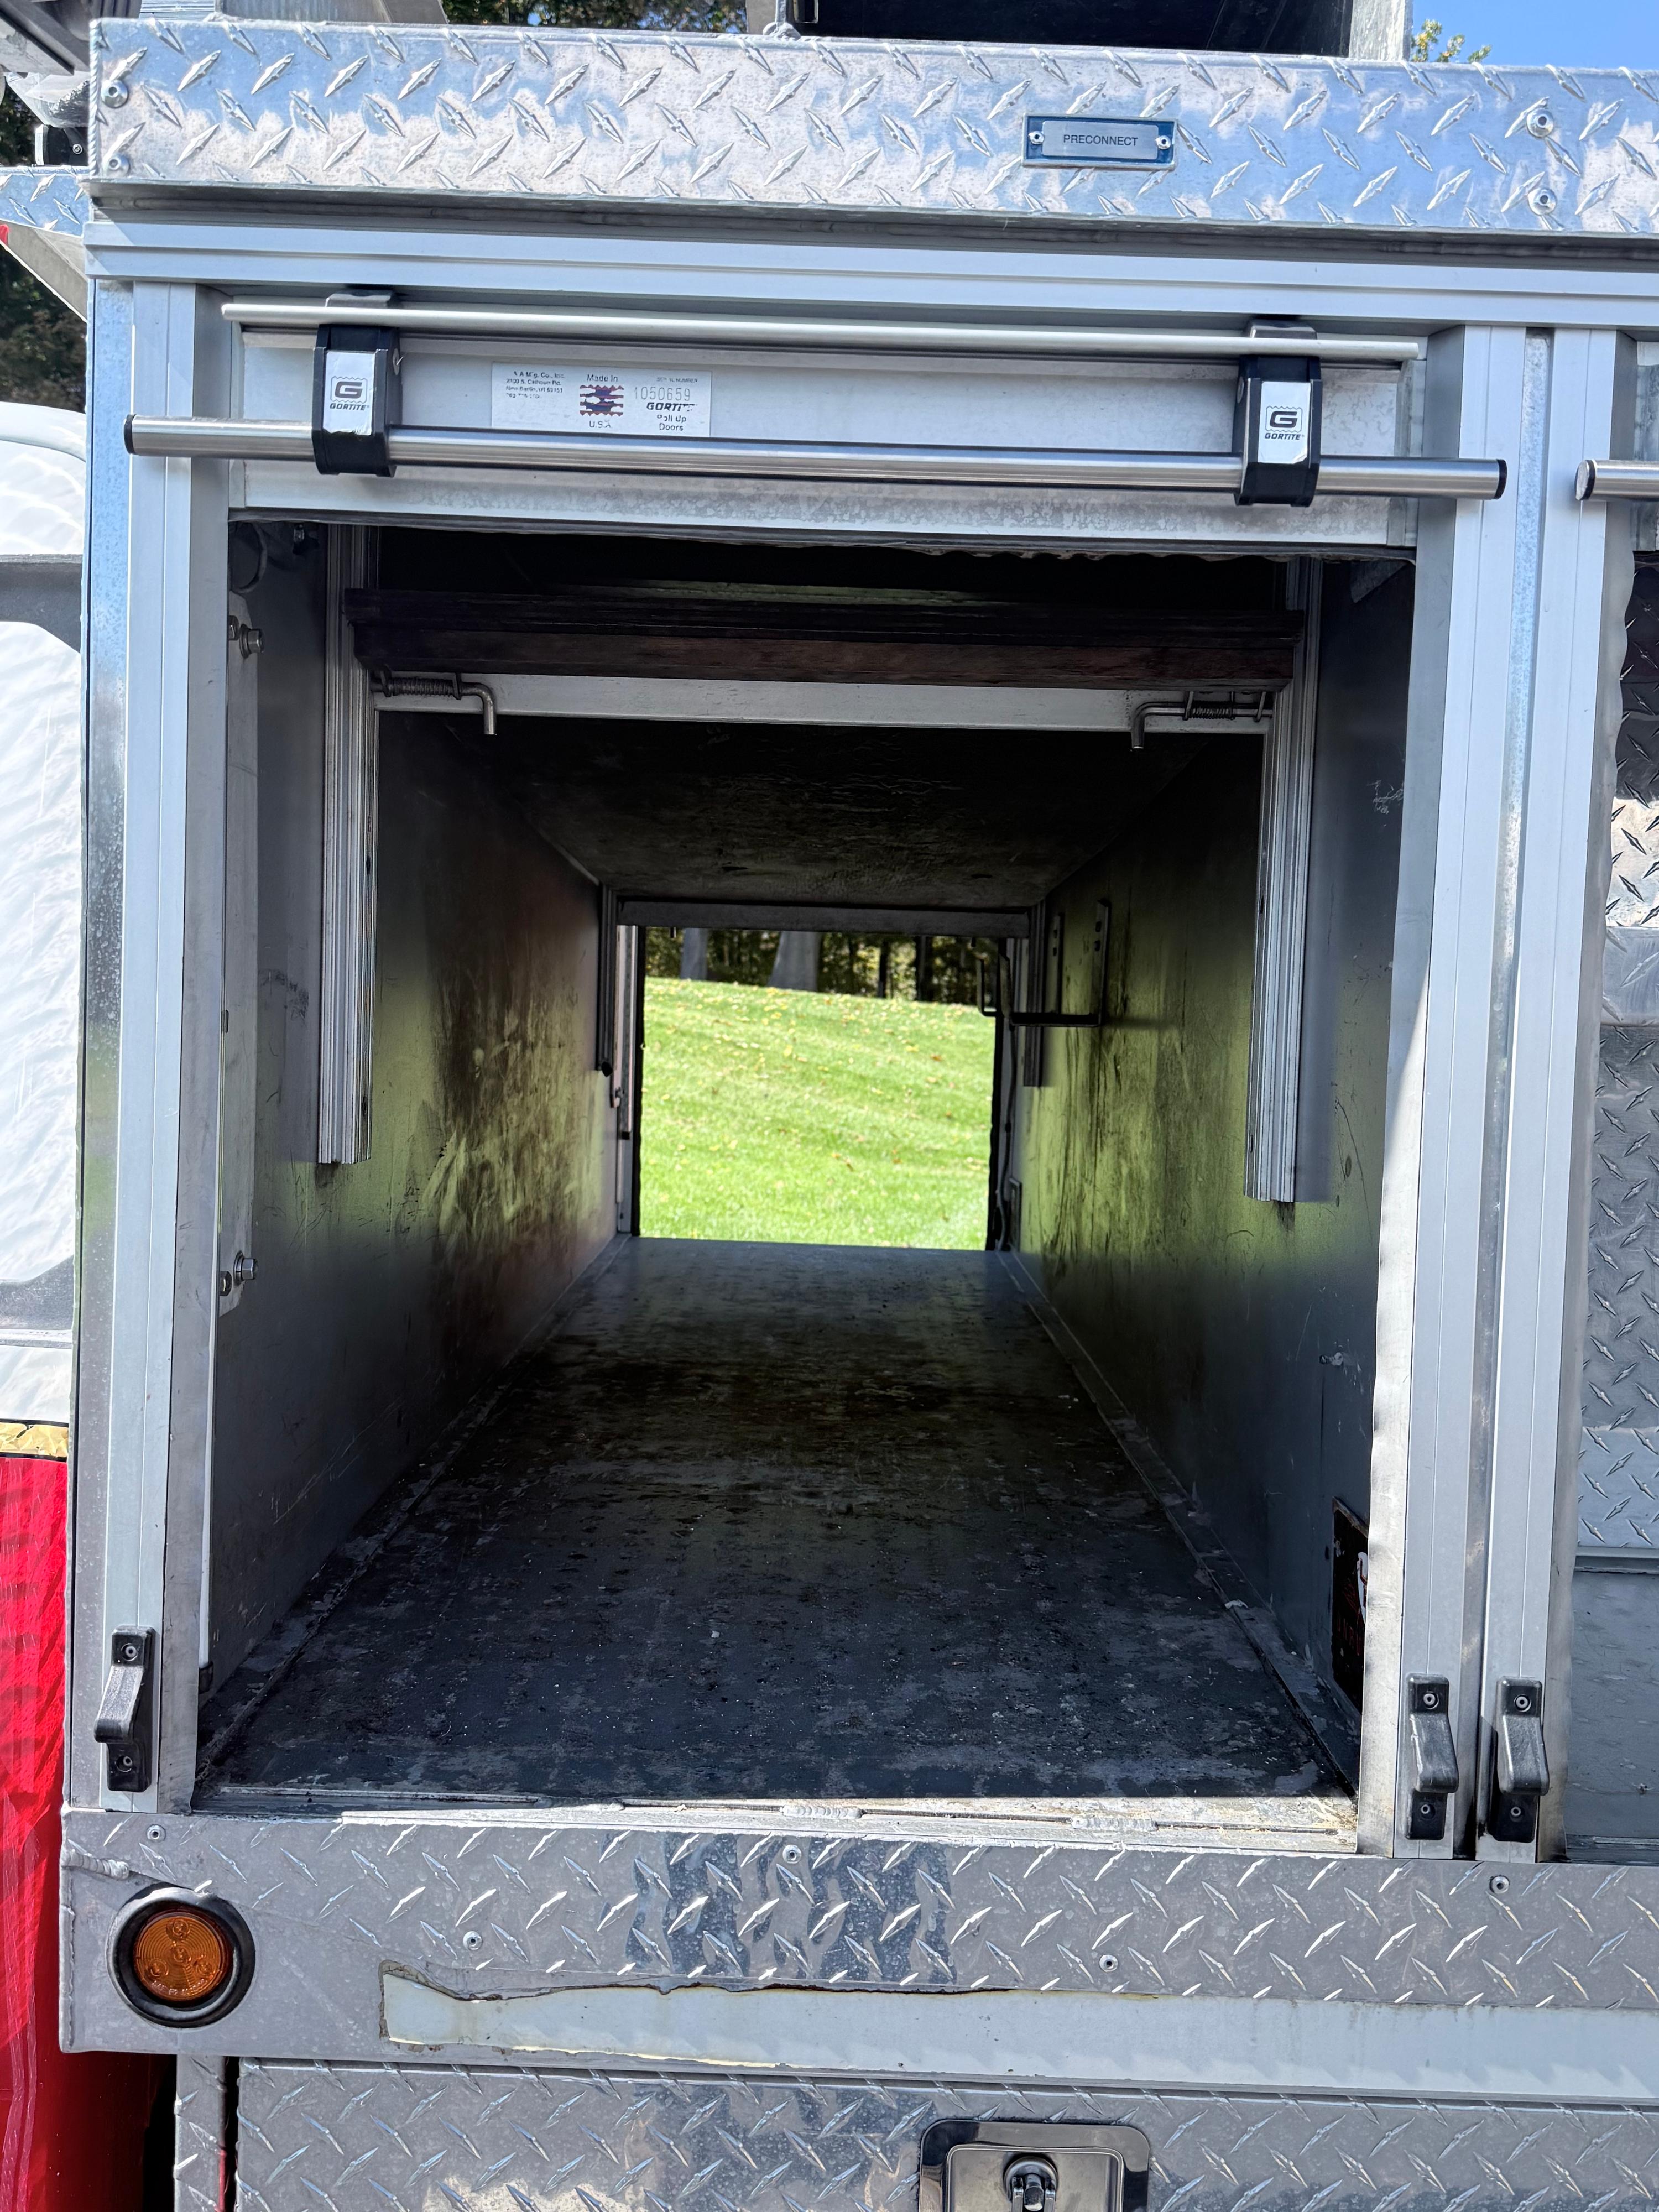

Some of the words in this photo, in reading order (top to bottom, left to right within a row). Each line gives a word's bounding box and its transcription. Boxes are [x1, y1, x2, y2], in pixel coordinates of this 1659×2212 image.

[1063, 134, 1138, 146] PRECONNECT
[335, 381, 363, 399] G
[634, 387, 690, 401] 1050659
[330, 403, 367, 411] GORTITE
[675, 415, 686, 423] Up
[1270, 411, 1298, 428] G
